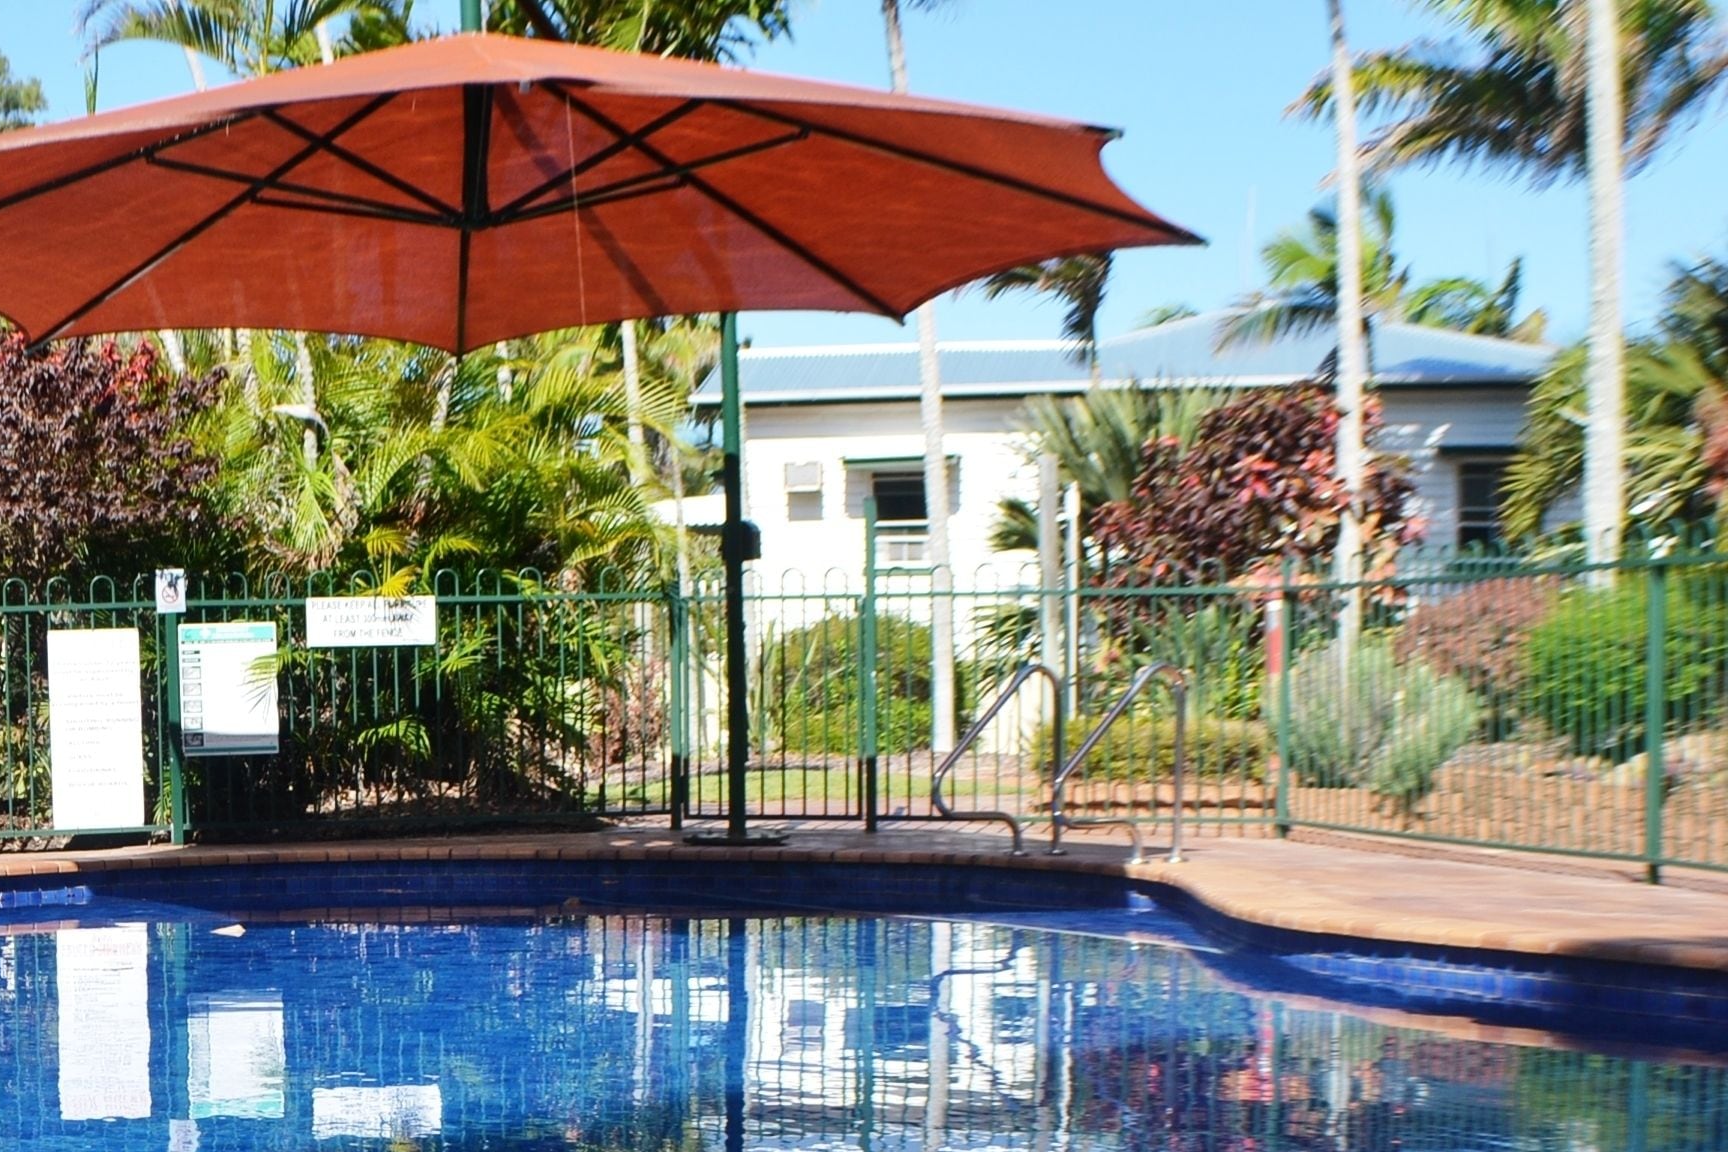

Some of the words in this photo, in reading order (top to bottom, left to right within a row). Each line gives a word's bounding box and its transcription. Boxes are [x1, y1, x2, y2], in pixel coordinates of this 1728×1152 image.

[311, 599, 341, 610] PLEASE
[344, 599, 366, 609] KEEP
[322, 614, 333, 623] AT
[335, 614, 360, 623] LEAST
[333, 629, 357, 638] FROM
[359, 628, 374, 638] THE
